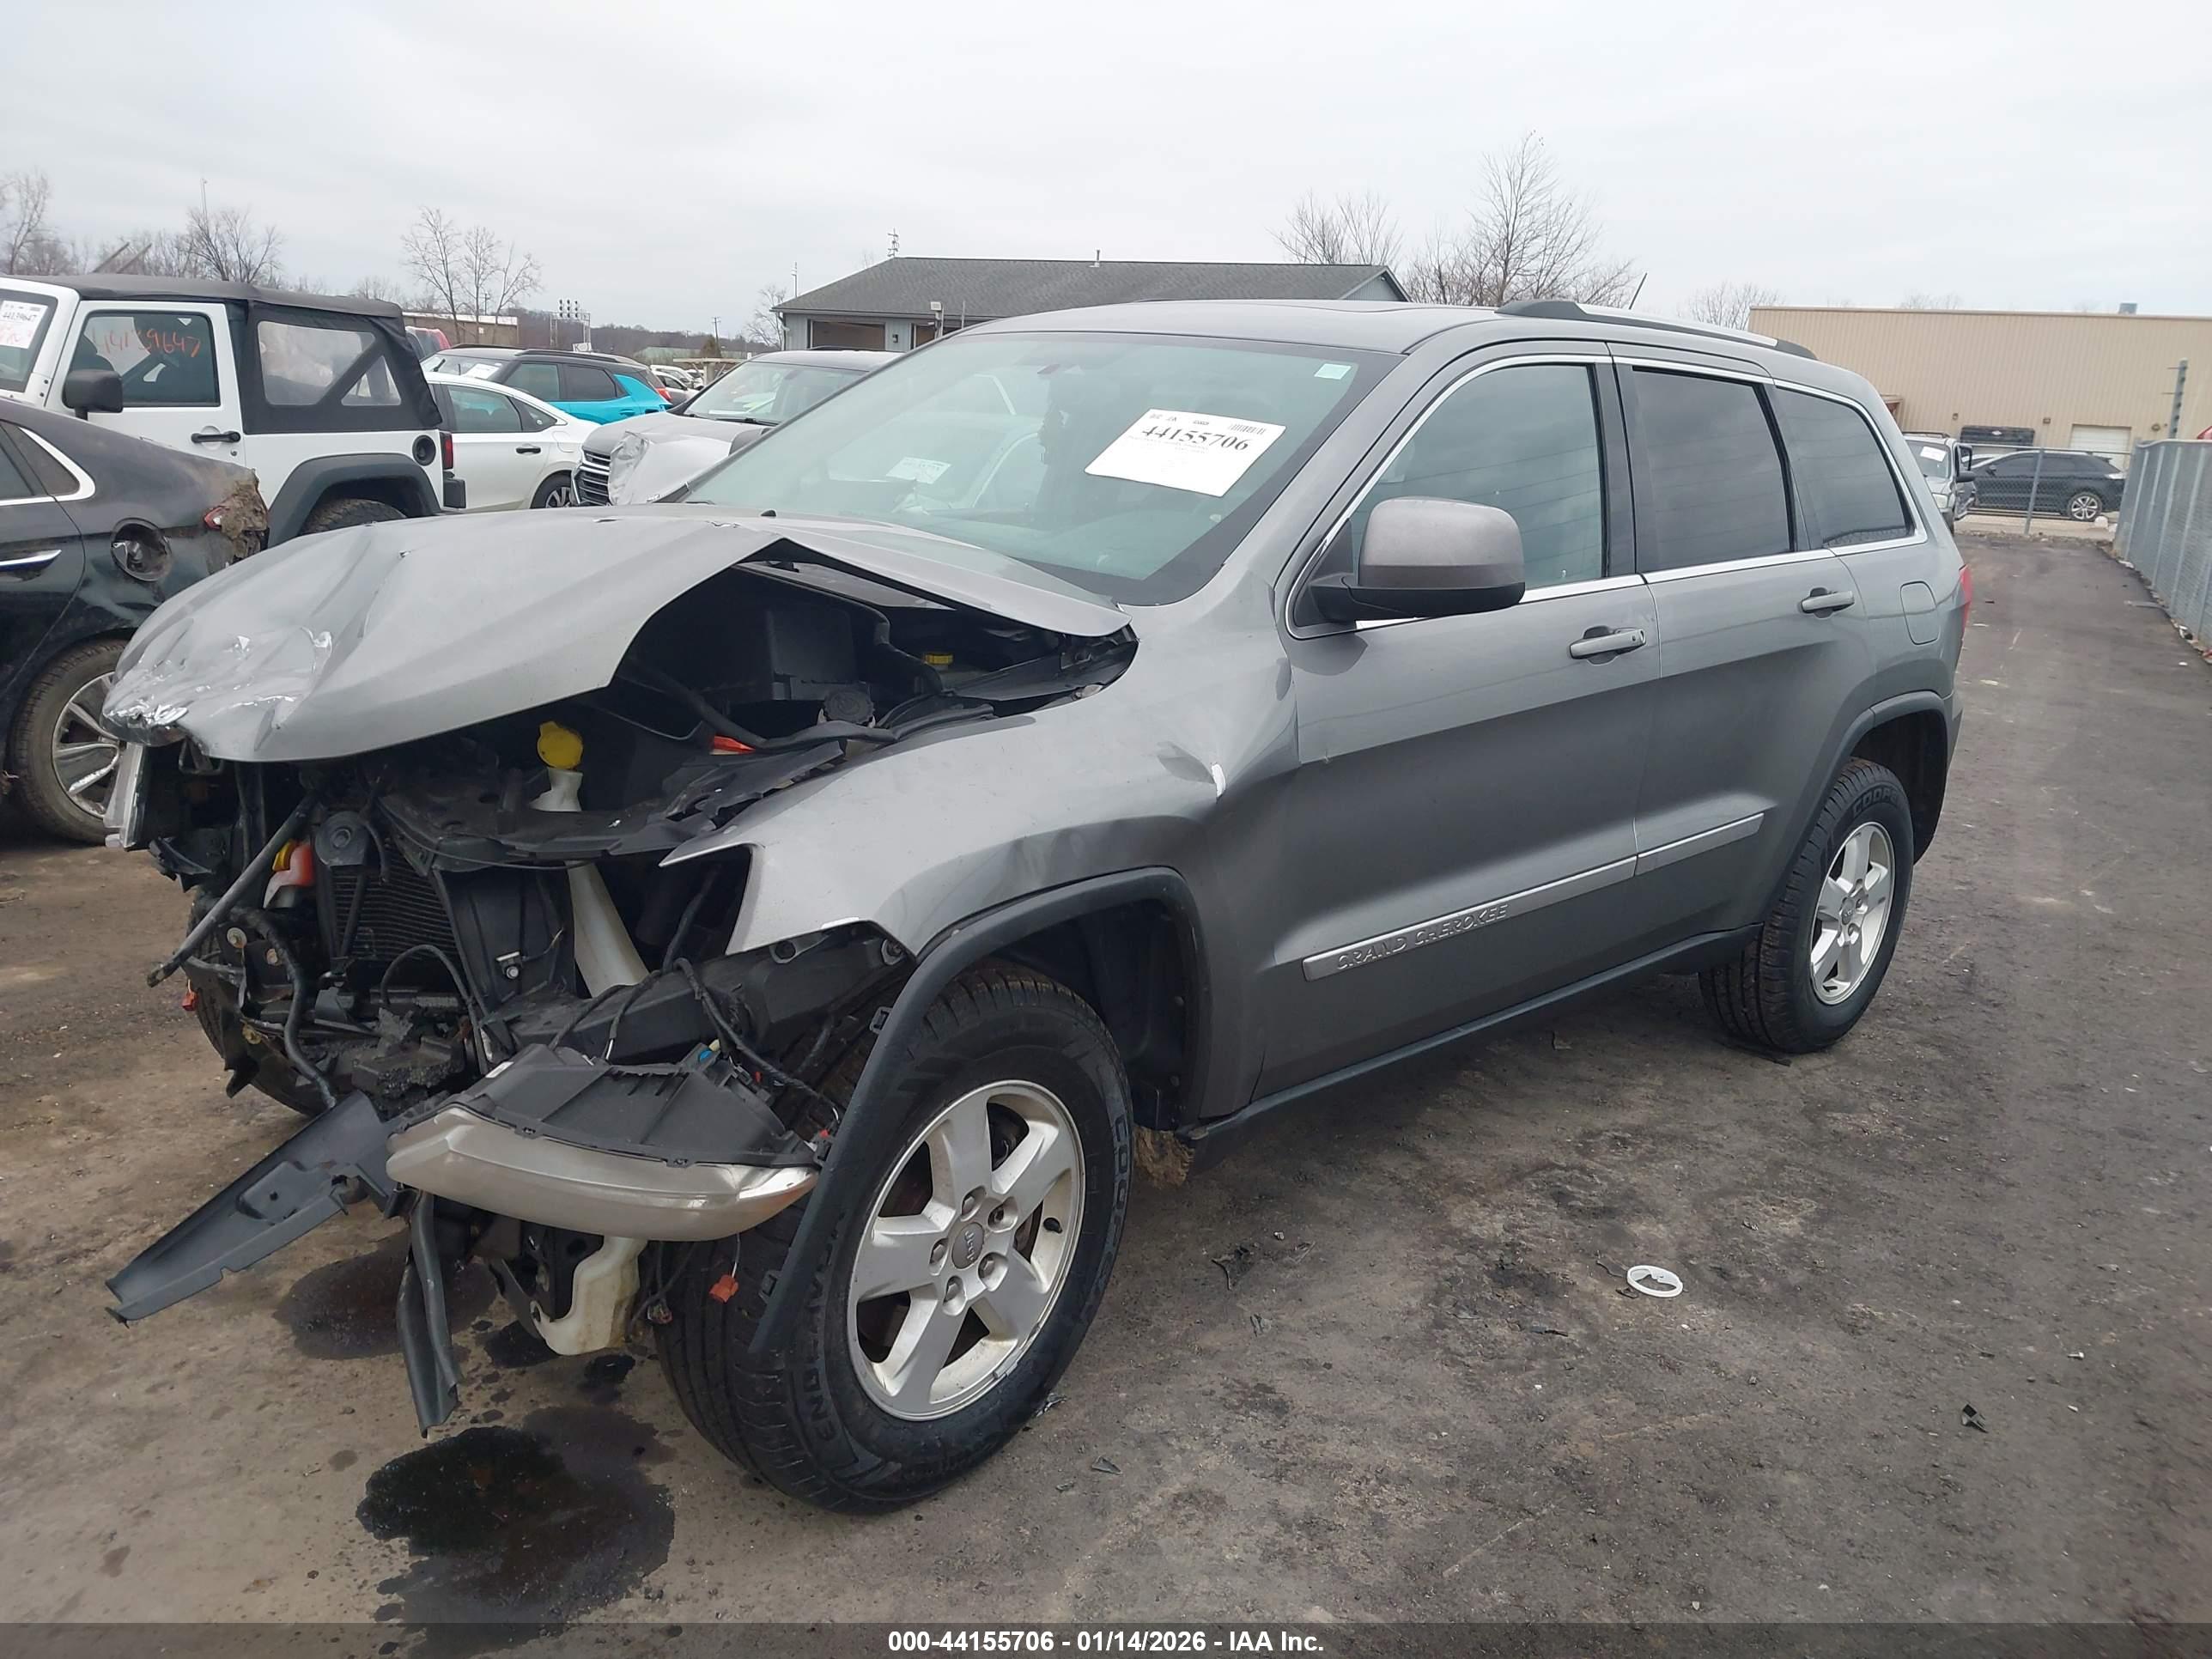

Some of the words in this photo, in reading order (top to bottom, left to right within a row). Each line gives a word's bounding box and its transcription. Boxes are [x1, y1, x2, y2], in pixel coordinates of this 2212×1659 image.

[1141, 425, 1252, 451] 44155706
[1337, 936, 1407, 970] GRAND
[1414, 903, 1509, 945] CHEROKEE
